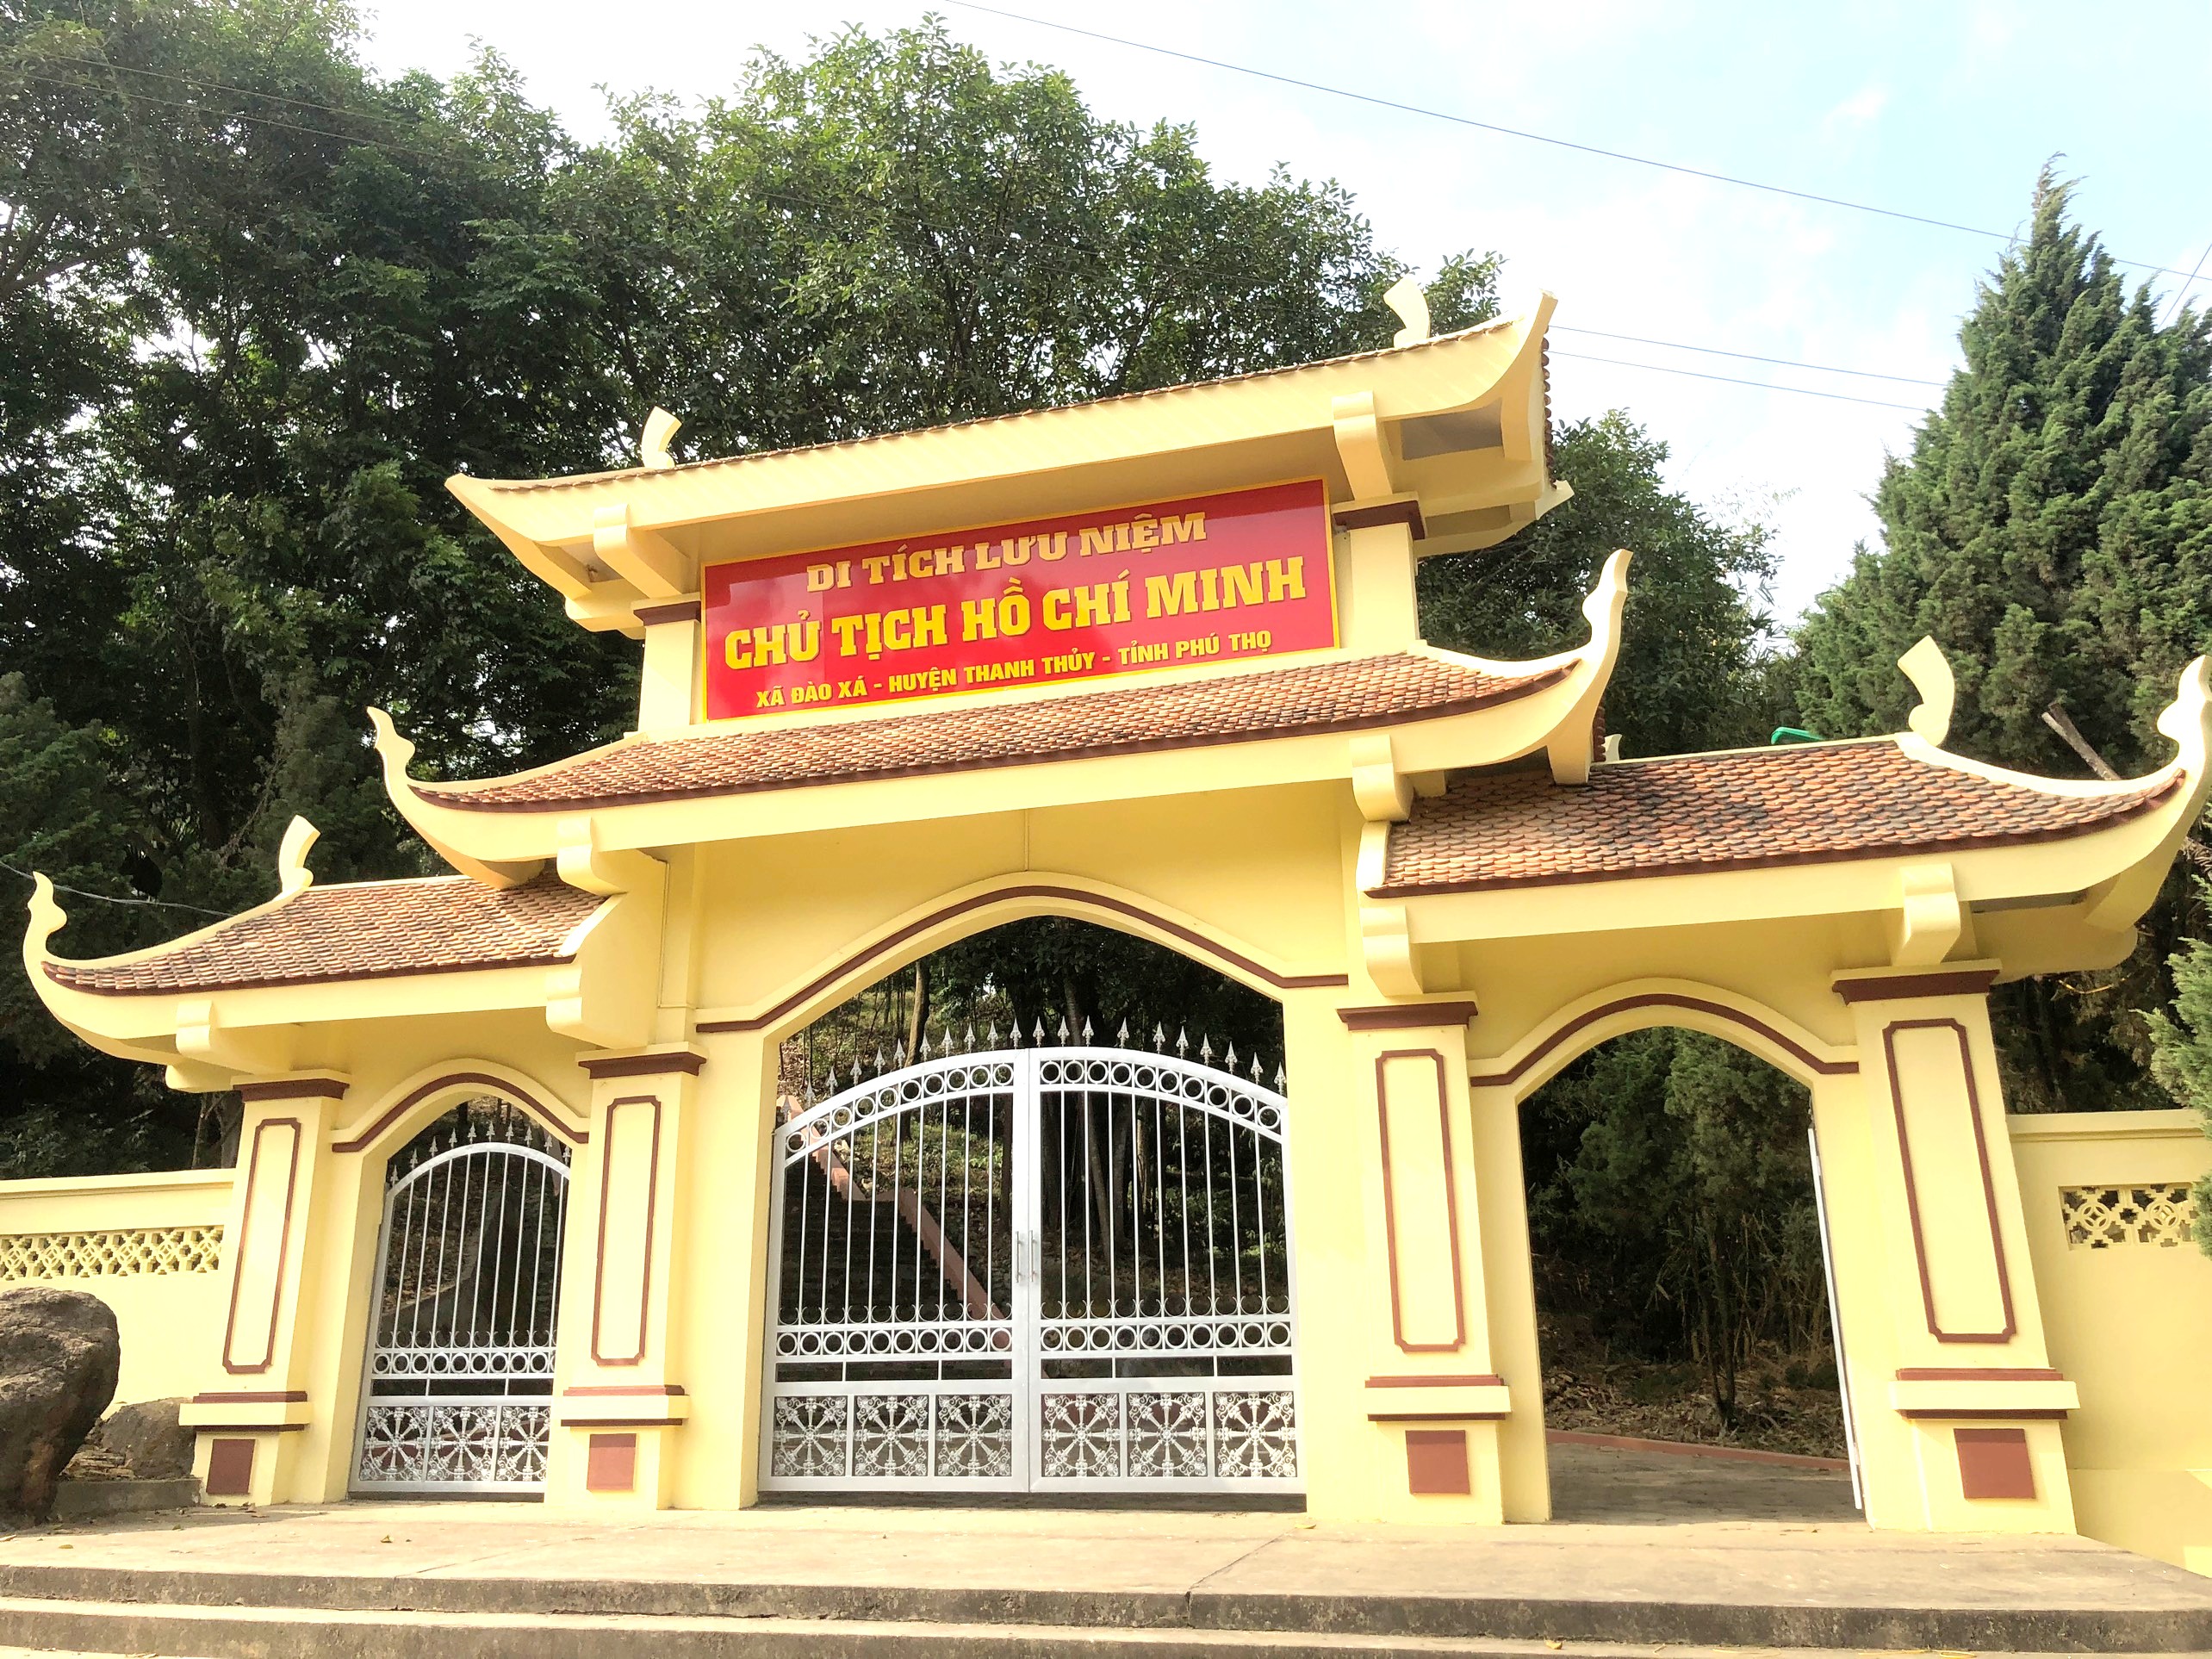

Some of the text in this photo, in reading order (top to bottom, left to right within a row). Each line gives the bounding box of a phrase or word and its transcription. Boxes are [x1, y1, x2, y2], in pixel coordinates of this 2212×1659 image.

[806, 512, 1207, 593] DI TÍCH LƯU NIỆM
[724, 556, 1307, 671] CHỦ TỊCH HỒ CHÍ MINH
[755, 684, 786, 708] XÃ
[790, 680, 833, 705] ĐÀO
[837, 674, 868, 699] XÁ
[888, 666, 959, 693] HUYỆN
[963, 658, 1035, 685] THANH
[1041, 646, 1097, 675] THỦY
[1117, 640, 1170, 664] TỈNH
[1174, 631, 1220, 660] PHÚ
[1227, 630, 1272, 653] THỌ
